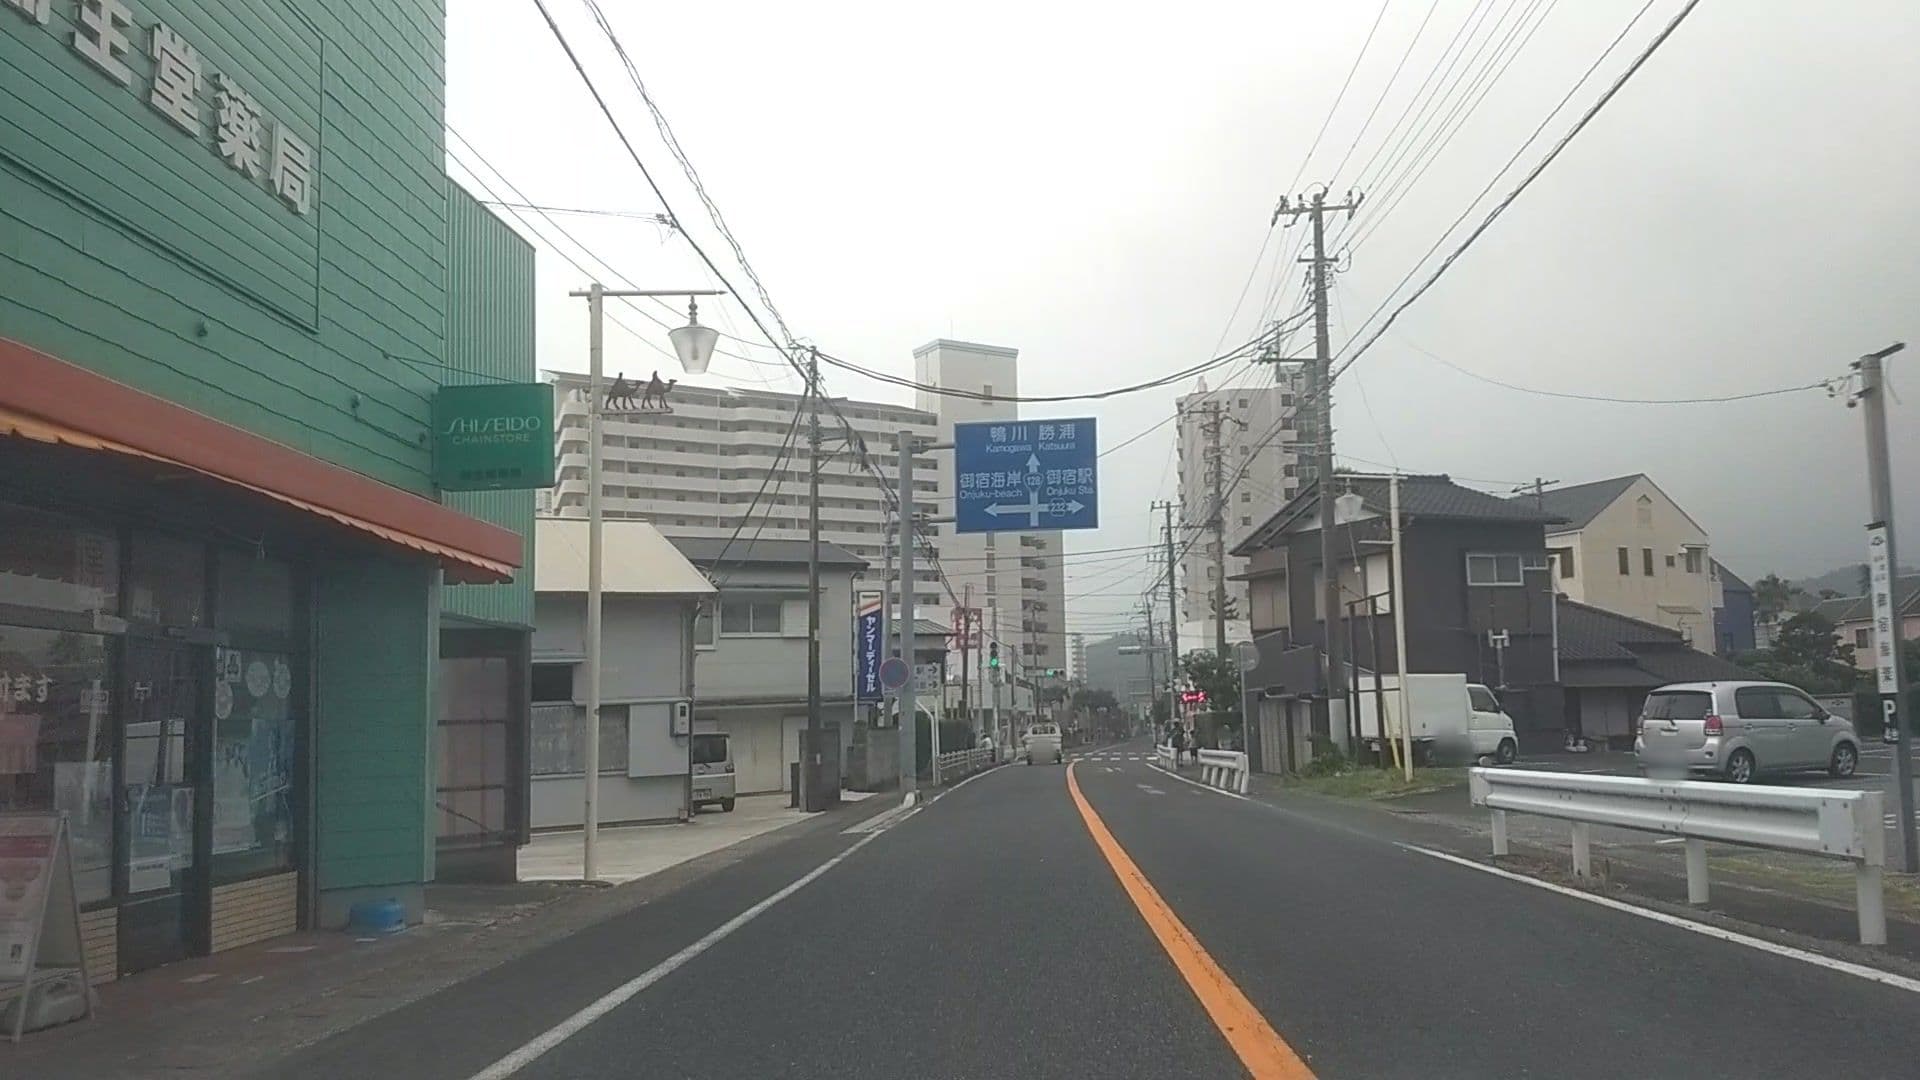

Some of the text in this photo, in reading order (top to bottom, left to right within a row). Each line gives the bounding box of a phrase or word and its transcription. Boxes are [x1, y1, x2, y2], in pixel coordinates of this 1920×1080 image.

[442, 416, 541, 435] SHISEIDO
[990, 424, 1075, 443] 鴨川 勝浦
[959, 471, 1022, 489] 御宿海岸
[1046, 467, 1093, 485] 御宿駅
[865, 615, 877, 693] ヤンマーディーゼル
[1882, 699, 1897, 723] P
